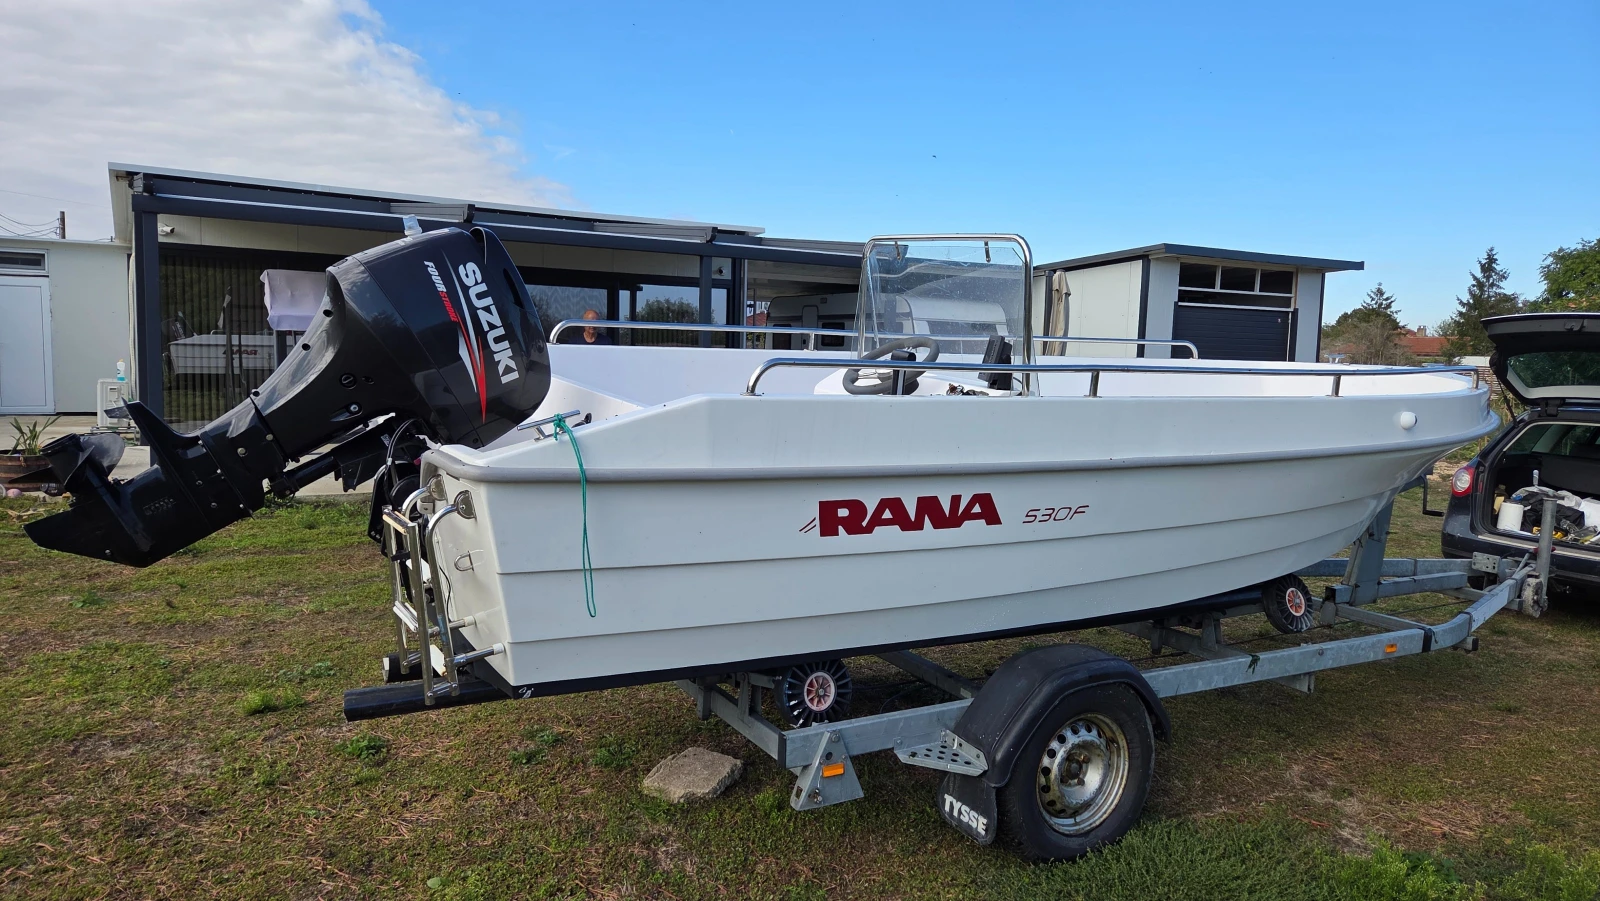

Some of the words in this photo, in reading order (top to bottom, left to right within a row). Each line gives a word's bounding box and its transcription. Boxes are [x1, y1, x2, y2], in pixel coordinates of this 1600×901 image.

[458, 260, 520, 385] SUZUKI
[818, 492, 1003, 538] RANA
[943, 793, 988, 837] TYSSE
